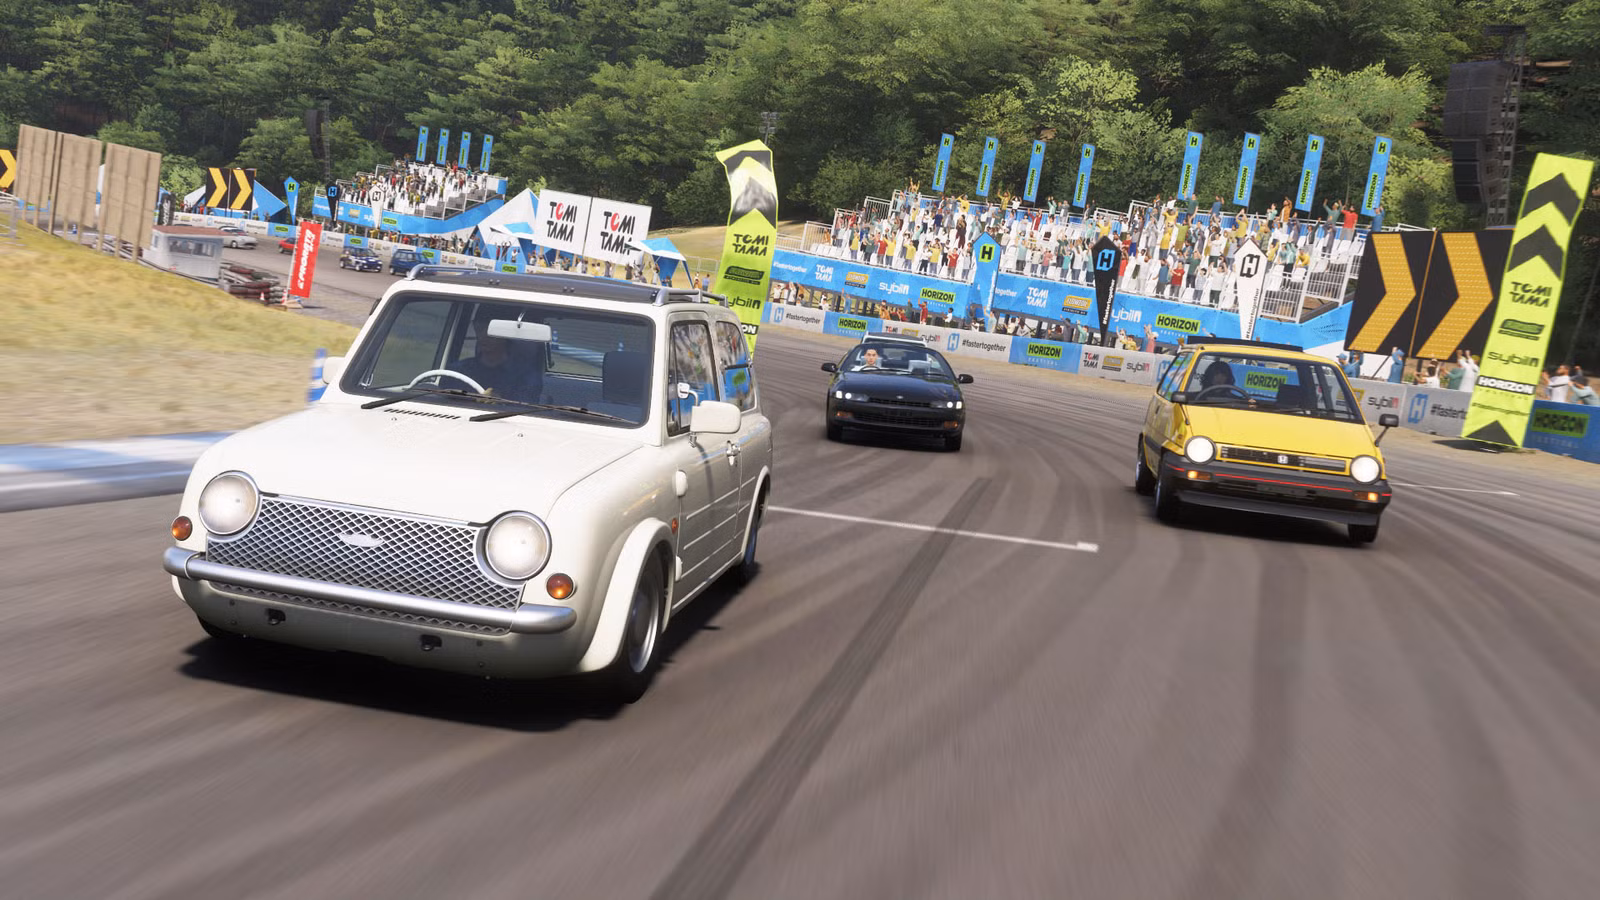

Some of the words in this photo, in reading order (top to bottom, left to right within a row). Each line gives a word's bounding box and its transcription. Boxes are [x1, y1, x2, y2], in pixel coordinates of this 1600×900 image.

[1238, 167, 1248, 200] HORIZON
[1300, 171, 1310, 204] HORIZON
[1367, 174, 1378, 209] HORIZON
[550, 201, 578, 223] TOMI
[604, 211, 636, 234] TOMI
[546, 220, 574, 242] TAMA
[734, 234, 768, 246] TOMI
[732, 243, 767, 256] TAMA
[922, 289, 954, 302] HORIZON
[1028, 287, 1048, 298] TOMI
[1511, 282, 1552, 296] TOMI
[1026, 296, 1046, 308] TAMA
[1103, 279, 1115, 325] #fastertogether
[1509, 292, 1550, 308] TAMA
[786, 313, 820, 324] #fastertogether
[839, 319, 867, 330] HORIZON
[1157, 316, 1199, 332] HORIZON
[962, 340, 1006, 352] #fastertogether
[1029, 344, 1061, 358] HORIZON
[1479, 376, 1533, 394] HORIZON
